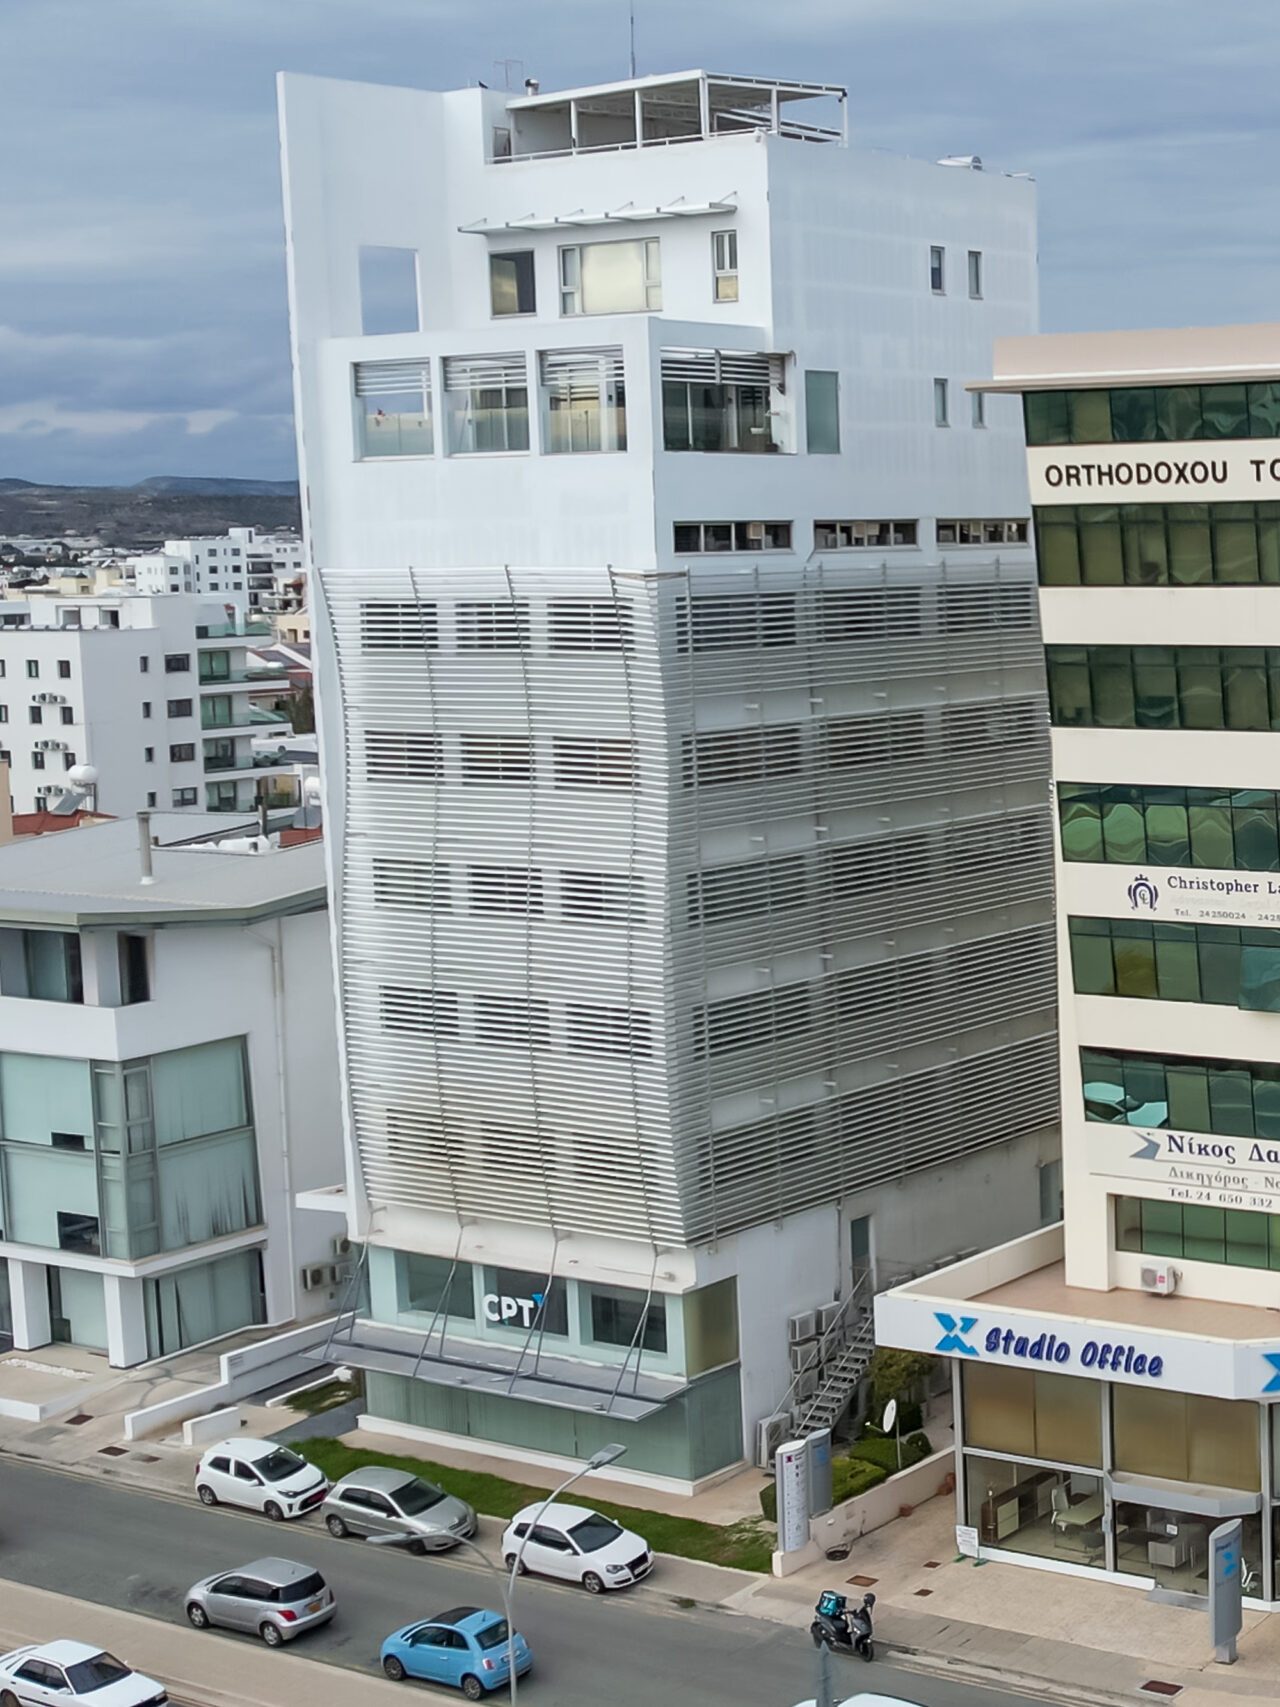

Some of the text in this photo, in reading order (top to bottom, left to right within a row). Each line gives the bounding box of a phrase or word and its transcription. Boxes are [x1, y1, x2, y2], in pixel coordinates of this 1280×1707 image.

[1045, 460, 1228, 488] ORTHODOXOU
[1167, 875, 1259, 895] Christopher
[1167, 1134, 1236, 1164] Νίκος
[1168, 1166, 1249, 1189] Δικηγόρος
[482, 1293, 534, 1327] CPT
[985, 1327, 1071, 1365] Studio
[1080, 1340, 1164, 1377] Office
